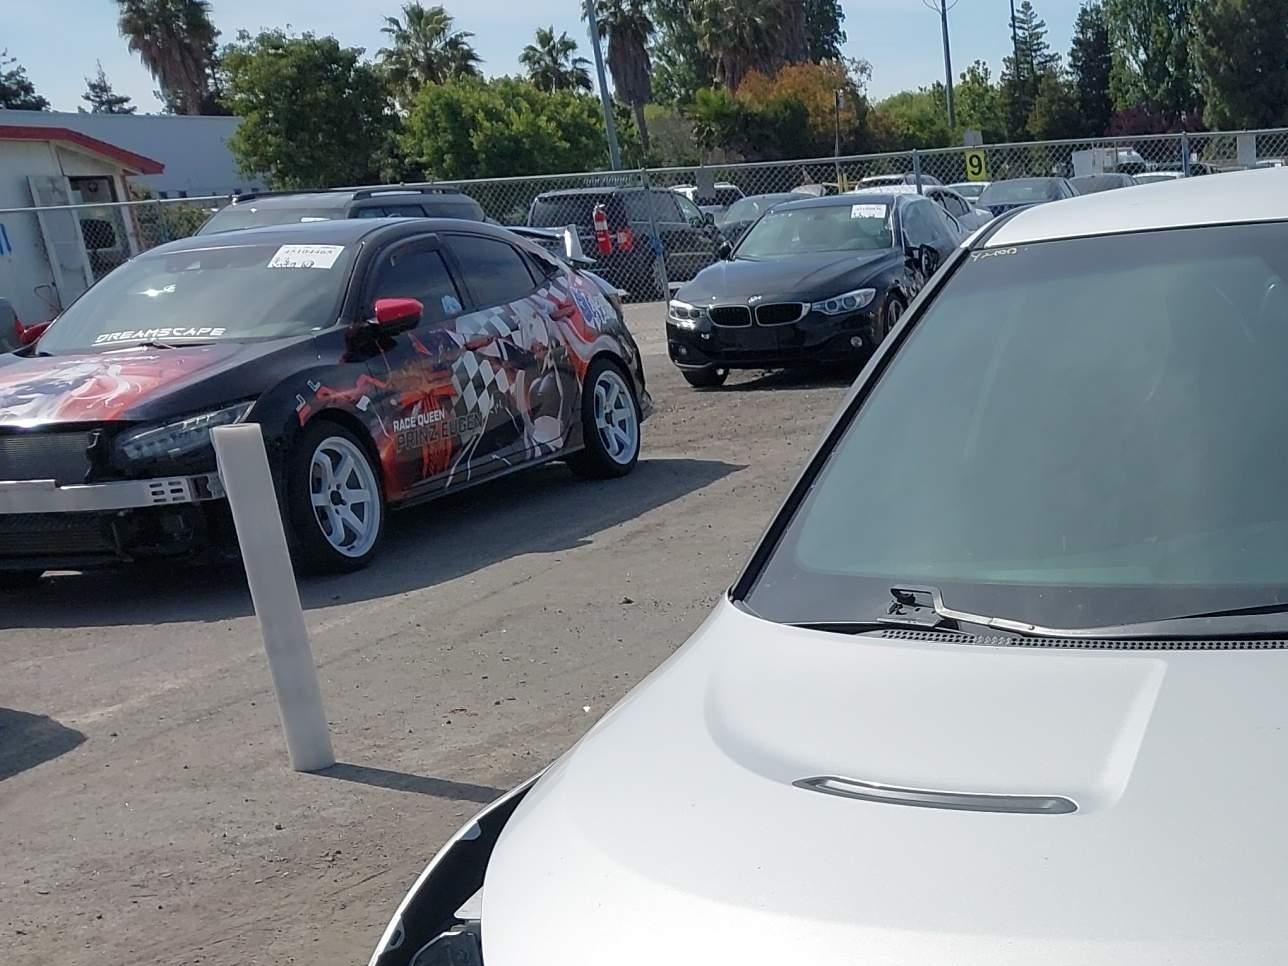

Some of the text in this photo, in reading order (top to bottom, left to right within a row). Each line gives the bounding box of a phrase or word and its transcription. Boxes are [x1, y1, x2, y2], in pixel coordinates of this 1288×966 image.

[969, 154, 982, 176] 9
[95, 327, 227, 343] DREAMSCAPE
[393, 409, 446, 432] RACE QUEEN
[396, 422, 439, 451] PRINZ
